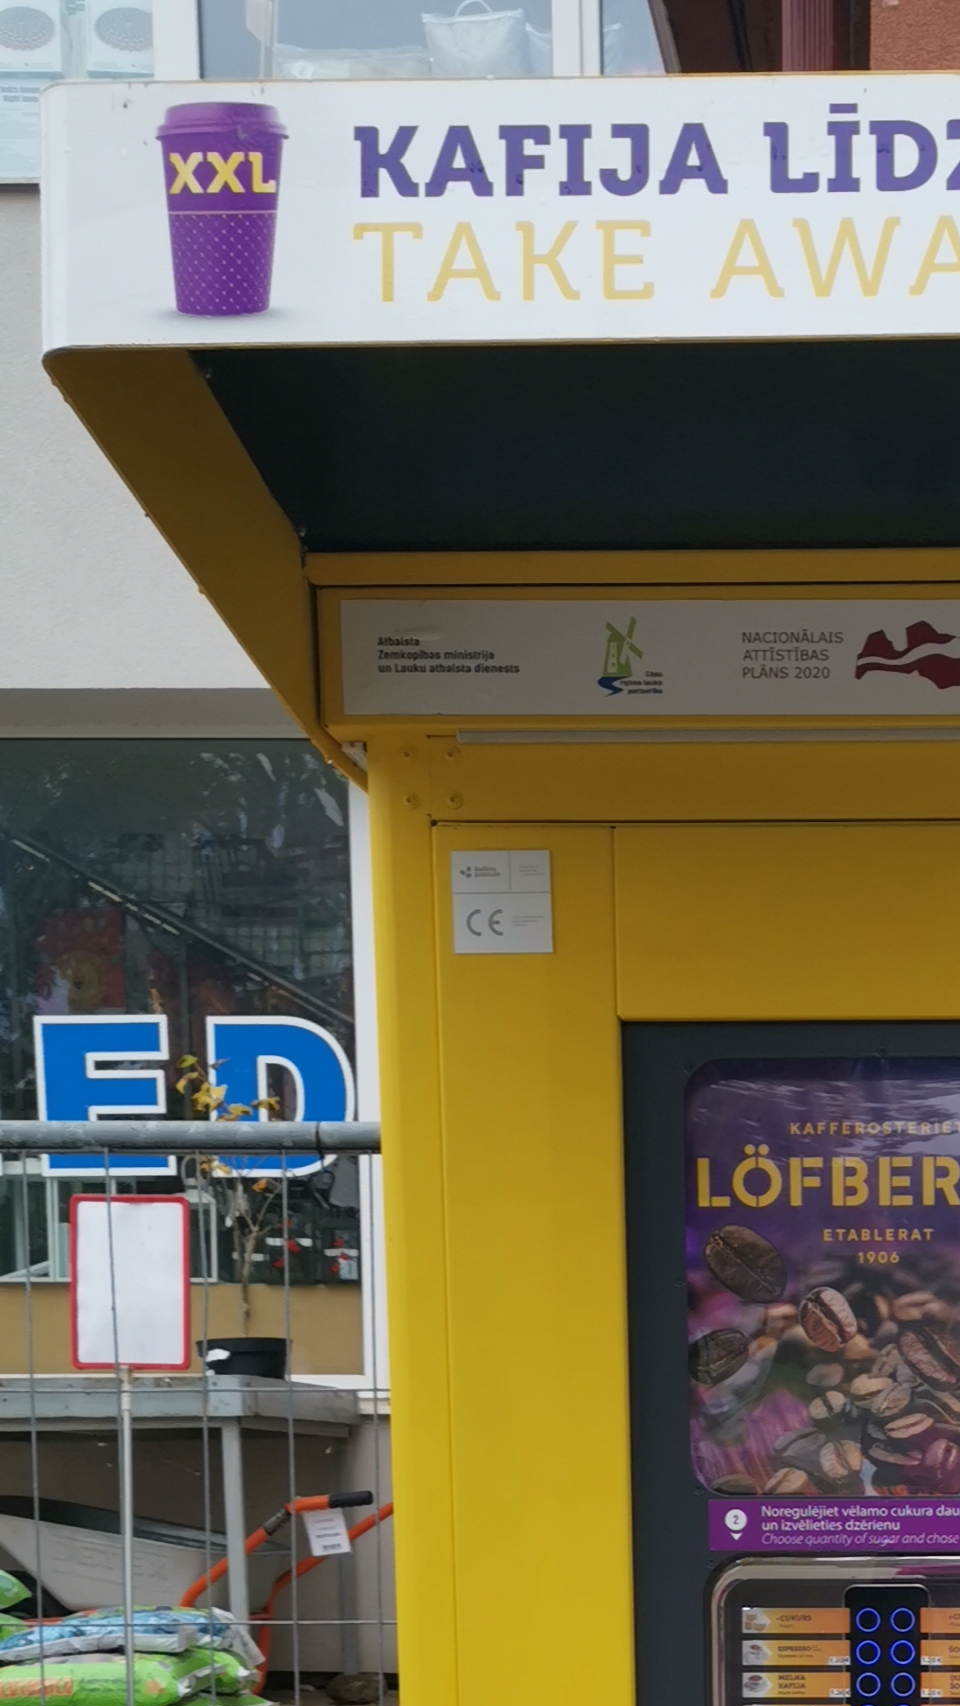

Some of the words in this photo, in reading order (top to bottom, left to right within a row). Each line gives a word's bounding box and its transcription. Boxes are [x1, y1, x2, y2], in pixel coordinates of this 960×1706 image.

[354, 121, 728, 199] KAFIJA
[169, 151, 278, 195] XXL
[353, 219, 656, 304] TAKE
[377, 636, 420, 648] Atbalsta
[741, 629, 844, 644] NACIONĀLAIS
[378, 649, 441, 661] Zemkopības
[444, 649, 495, 661] ministrija
[743, 646, 829, 661] ATTĪSTĪBAS
[378, 664, 392, 673] un
[394, 663, 427, 673] Lauku
[429, 663, 472, 673] atbalsta
[474, 663, 520, 674] dienests
[742, 664, 789, 679] PLĀNS
[794, 666, 831, 679] 2020
[0, 1014, 356, 1178] ED
[822, 1228, 934, 1242] ETABLERAT
[857, 1250, 900, 1264] 1906
[761, 1504, 839, 1518] Noregulējiet
[841, 1504, 888, 1517] vēlamo
[890, 1505, 933, 1517] cukura
[733, 1514, 740, 1526] 2
[761, 1521, 778, 1531] un
[781, 1518, 842, 1531] izvēlieties
[845, 1518, 901, 1531] dzērienu
[761, 1532, 803, 1544] Choose
[805, 1532, 851, 1547] quantity
[853, 1532, 867, 1546] of
[868, 1534, 900, 1547] sugar
[901, 1532, 924, 1544] and
[926, 1532, 958, 1544] chose
